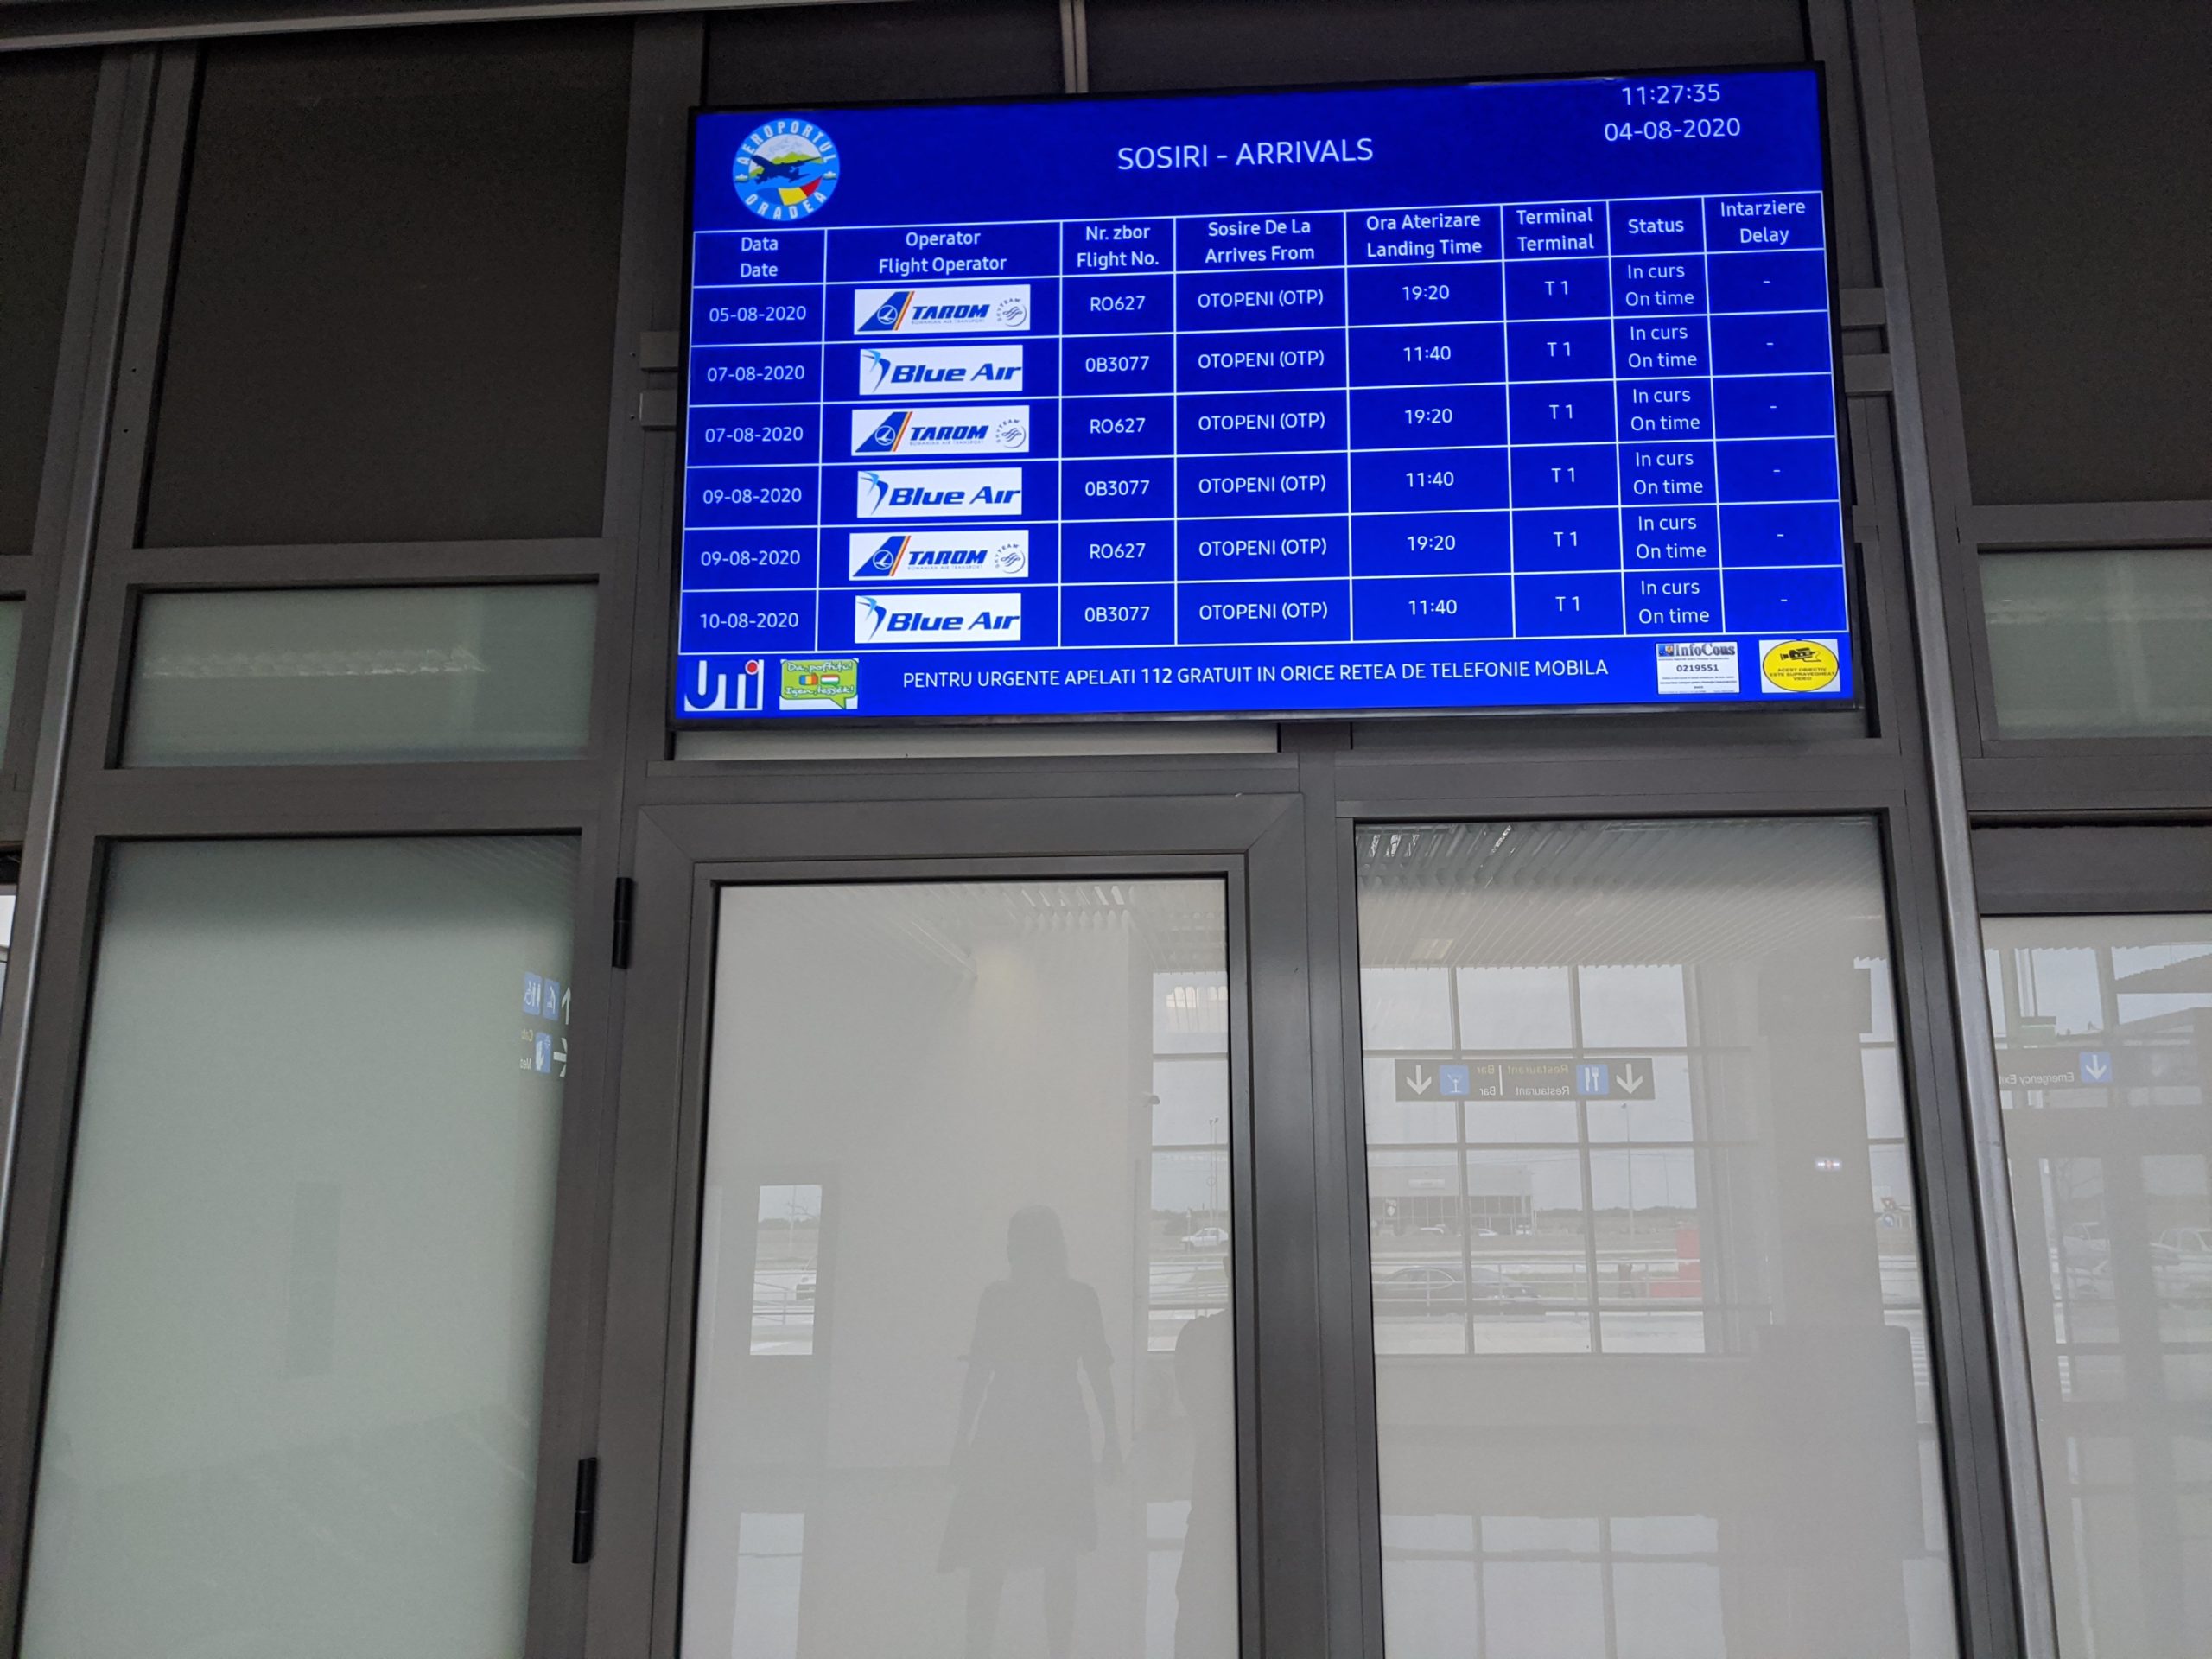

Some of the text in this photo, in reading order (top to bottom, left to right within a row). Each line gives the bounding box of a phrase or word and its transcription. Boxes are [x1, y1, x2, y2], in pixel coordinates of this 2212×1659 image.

[1622, 83, 1720, 105] 11:27:35
[1605, 118, 1740, 142] 04-08-2020
[736, 120, 837, 166] AEROPORTUL
[1118, 144, 1207, 170] SOSIRI
[1236, 137, 1373, 166] ARRIVALS
[744, 191, 828, 220] ORADEA
[1720, 200, 1806, 217] Intarziere
[1366, 213, 1481, 231] Ora Aterizare
[1516, 207, 1593, 225] Terminal
[1085, 224, 1151, 241] Nr. zbor
[1208, 219, 1311, 237] Sosire De La
[1628, 219, 1684, 234] Status
[741, 237, 779, 251] Data
[906, 231, 981, 250] Operator
[1516, 233, 1594, 251] Terminal
[1740, 226, 1789, 245] Delay
[1205, 245, 1315, 264] Arrives From
[1367, 239, 1482, 259] Landing Time
[879, 256, 1007, 277] Flight Operator
[1077, 251, 1159, 271] Flight No.
[741, 263, 779, 277] Date
[1628, 264, 1685, 279] In curs
[1198, 289, 1324, 308] OTOPENI (OTP)
[1402, 284, 1450, 301] 19:20
[1625, 290, 1694, 307] On time
[912, 303, 990, 320] TAROM
[1090, 295, 1146, 312] RO627
[709, 305, 806, 322] 05-08-2020
[1630, 326, 1688, 340] In curs
[1198, 349, 1325, 369] OTOPENI (OTP)
[1403, 346, 1452, 362] 11:40
[1628, 353, 1697, 368] On time
[1085, 355, 1150, 372] 0B3077
[707, 365, 805, 382] 07-08-2020
[890, 363, 1022, 384] Blue Air
[1633, 388, 1691, 404] In curs
[1198, 411, 1325, 431] OTOPENI (OTP)
[1405, 408, 1452, 424] 19:20
[1630, 415, 1700, 431] On time
[705, 426, 804, 442] 07-08-2020
[910, 425, 989, 441] TAROM
[1090, 417, 1146, 434] RO627
[1636, 452, 1694, 467] In curs
[1198, 474, 1326, 493] OTOPENI (OTP)
[1406, 471, 1454, 487] 11:40
[1633, 479, 1703, 495] On time
[703, 487, 802, 505] 09-08-2020
[888, 486, 1021, 506] Blue Air
[1084, 480, 1150, 497] 0B3077
[1638, 516, 1697, 531] In curs
[1090, 543, 1146, 559] RO627
[1198, 537, 1327, 556] OTOPENI (OTP)
[1407, 535, 1456, 551] 19:20
[1636, 543, 1707, 559] On time
[701, 550, 800, 566] 09-08-2020
[908, 550, 988, 565] TAROM
[1641, 580, 1700, 595] In curs
[1084, 606, 1150, 623] 0B3077
[1199, 601, 1328, 620] OTOPENI (OTP)
[1408, 599, 1458, 615] 11:40
[1638, 607, 1710, 624] On time
[701, 612, 799, 629] 10-08-2020
[887, 611, 1020, 632] Blue Air
[903, 659, 1609, 688] PENTRU URGENTE APELATI 112 GRATUIT IN ORICE RETEA DE TELEFONIE MOBILA
[1676, 664, 1719, 672] 0219551
